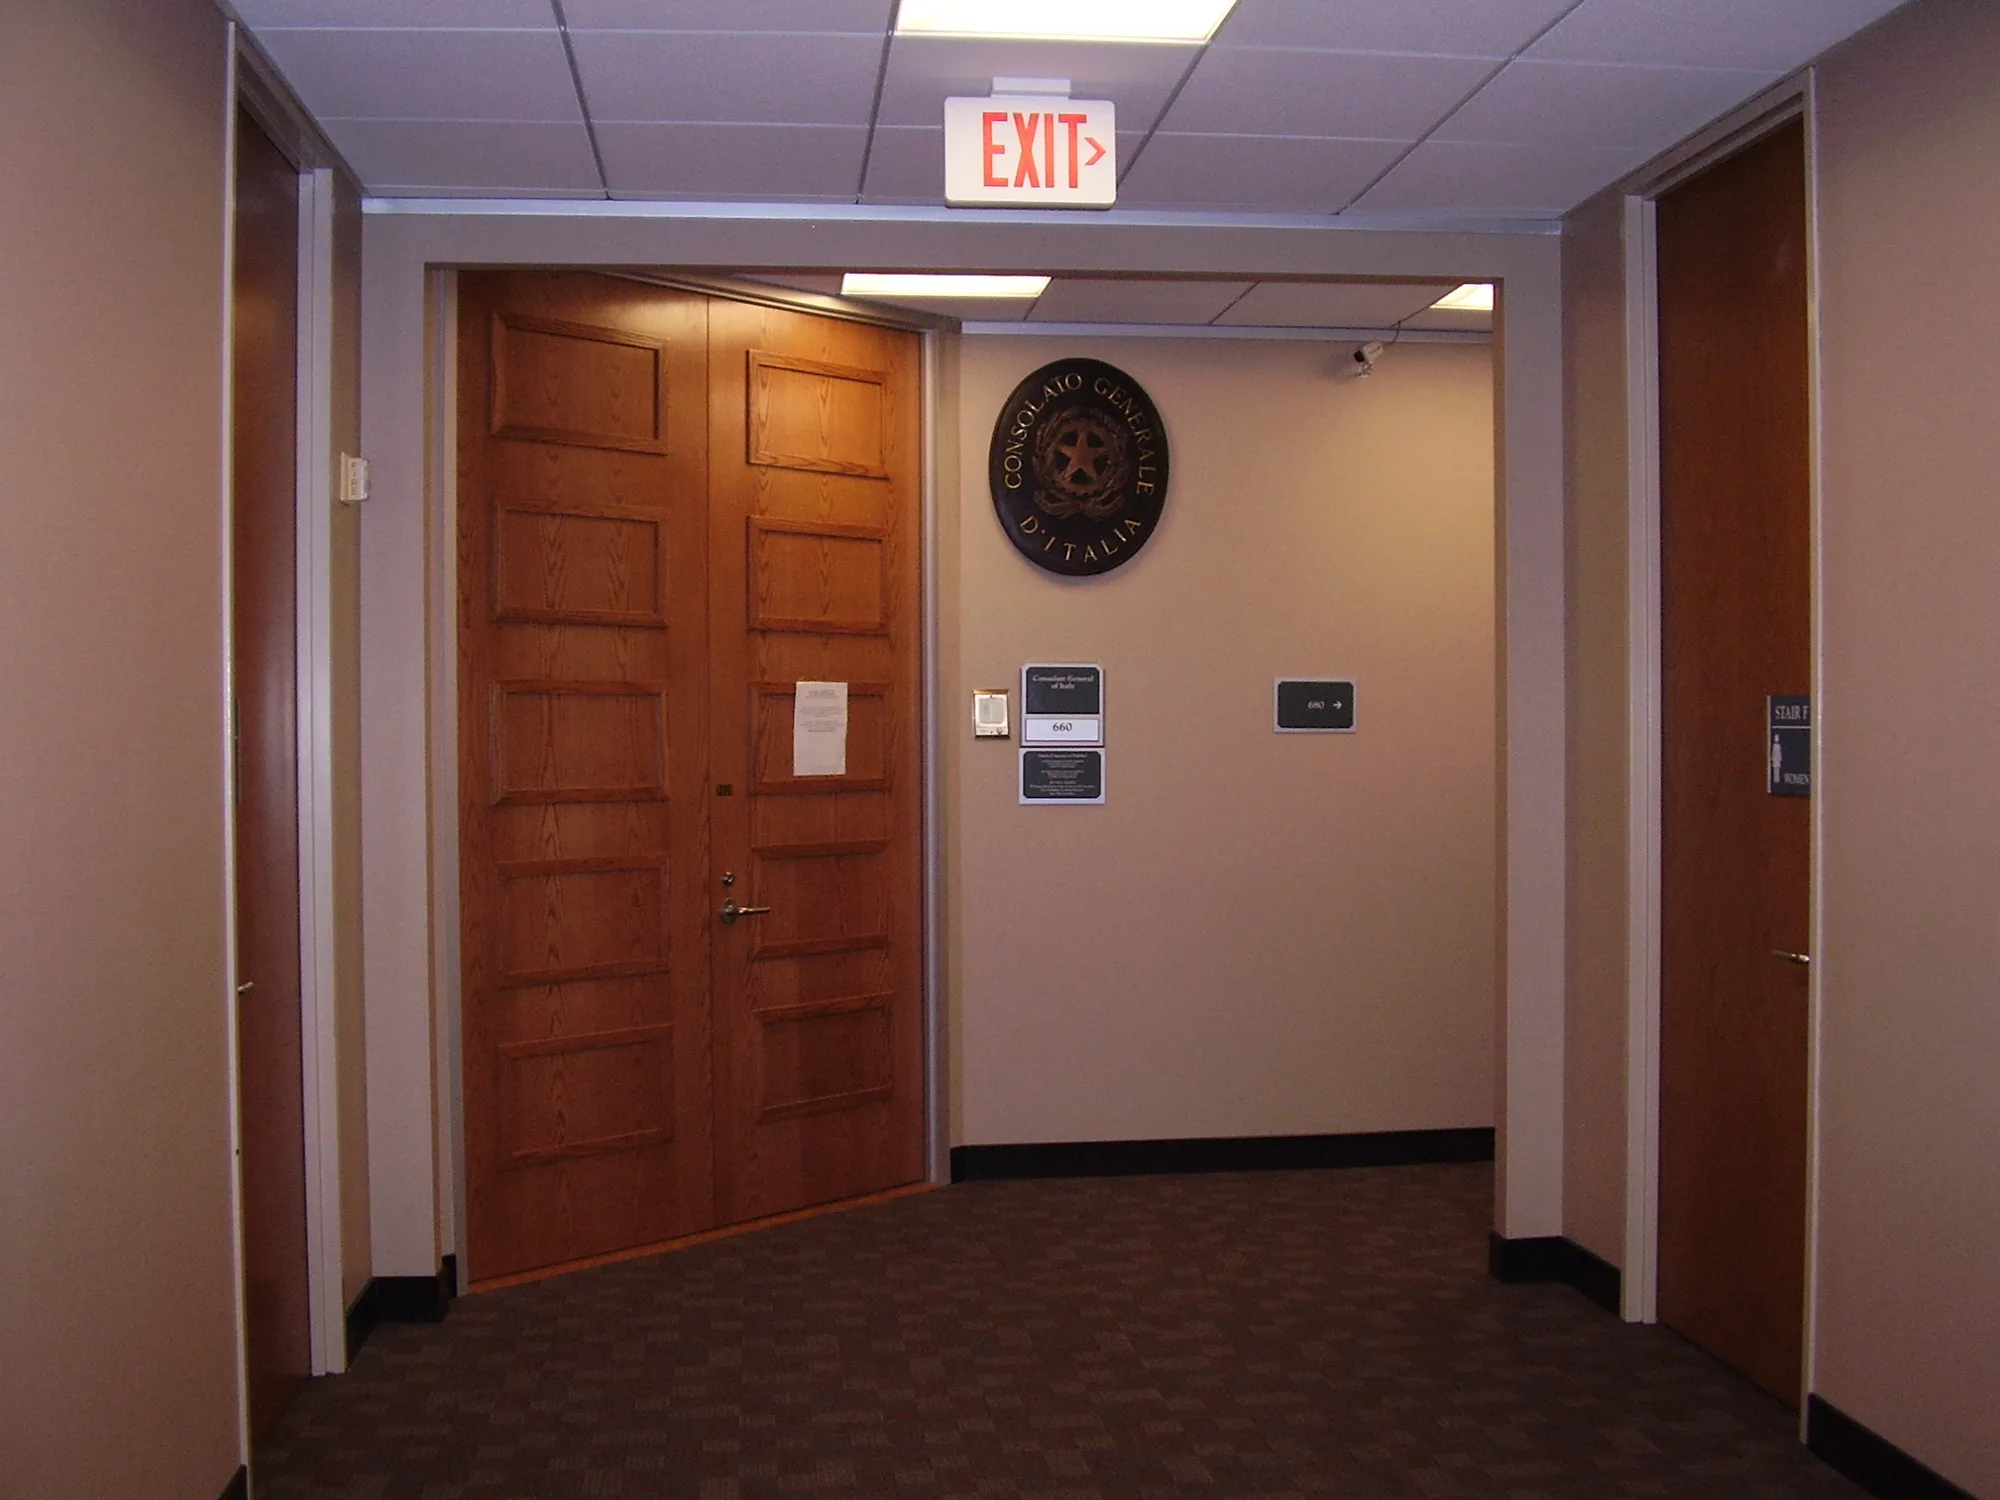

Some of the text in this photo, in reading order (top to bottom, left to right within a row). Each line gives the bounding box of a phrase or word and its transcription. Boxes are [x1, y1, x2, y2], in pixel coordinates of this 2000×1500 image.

[982, 111, 1087, 188] EXIT
[1004, 372, 1157, 496] CONSOLATO GENERALE
[1067, 674, 1095, 682] General
[1059, 682, 1076, 691] Italy
[1775, 705, 1801, 720] STAIR
[1052, 721, 1073, 732] 660
